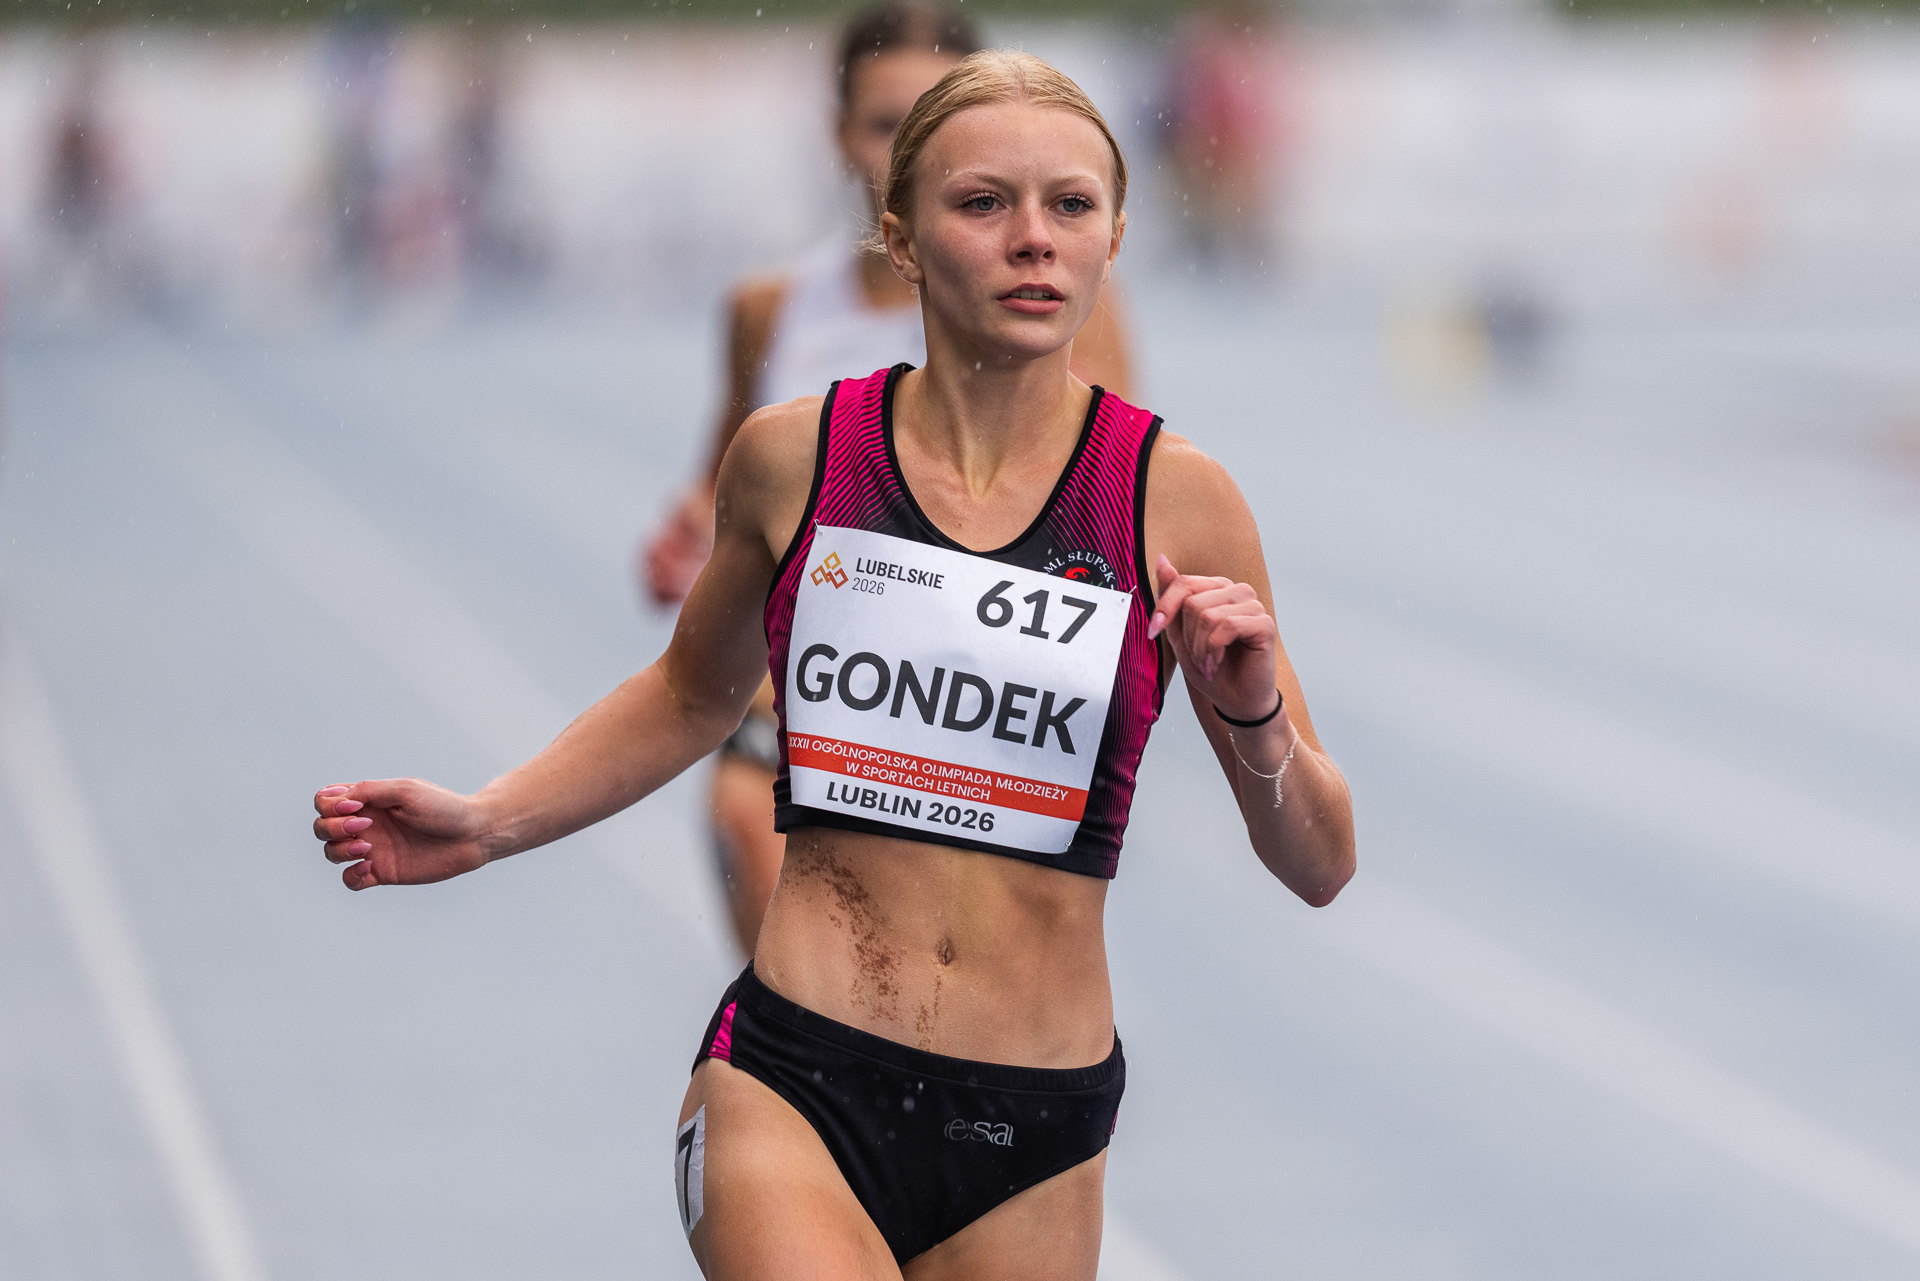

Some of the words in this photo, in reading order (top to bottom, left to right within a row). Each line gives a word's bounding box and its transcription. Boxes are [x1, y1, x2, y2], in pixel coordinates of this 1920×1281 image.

[852, 577, 885, 595] 2026
[856, 557, 945, 589] LUBELSKIE
[1067, 550, 1116, 583] SŁUPSK
[976, 580, 1098, 644] 617
[796, 643, 1088, 755] GONDEK
[811, 740, 918, 772] OGÓLNOPOLSKA
[921, 762, 993, 787] OLIMPIADA
[995, 776, 1069, 801] MŁODZIEŻY
[845, 761, 860, 774] W
[861, 764, 935, 791] SPORTACH
[936, 780, 991, 801] LETNICH
[826, 781, 922, 819] LUBLIN
[926, 802, 996, 832] 2026
[677, 1121, 697, 1226] 7
